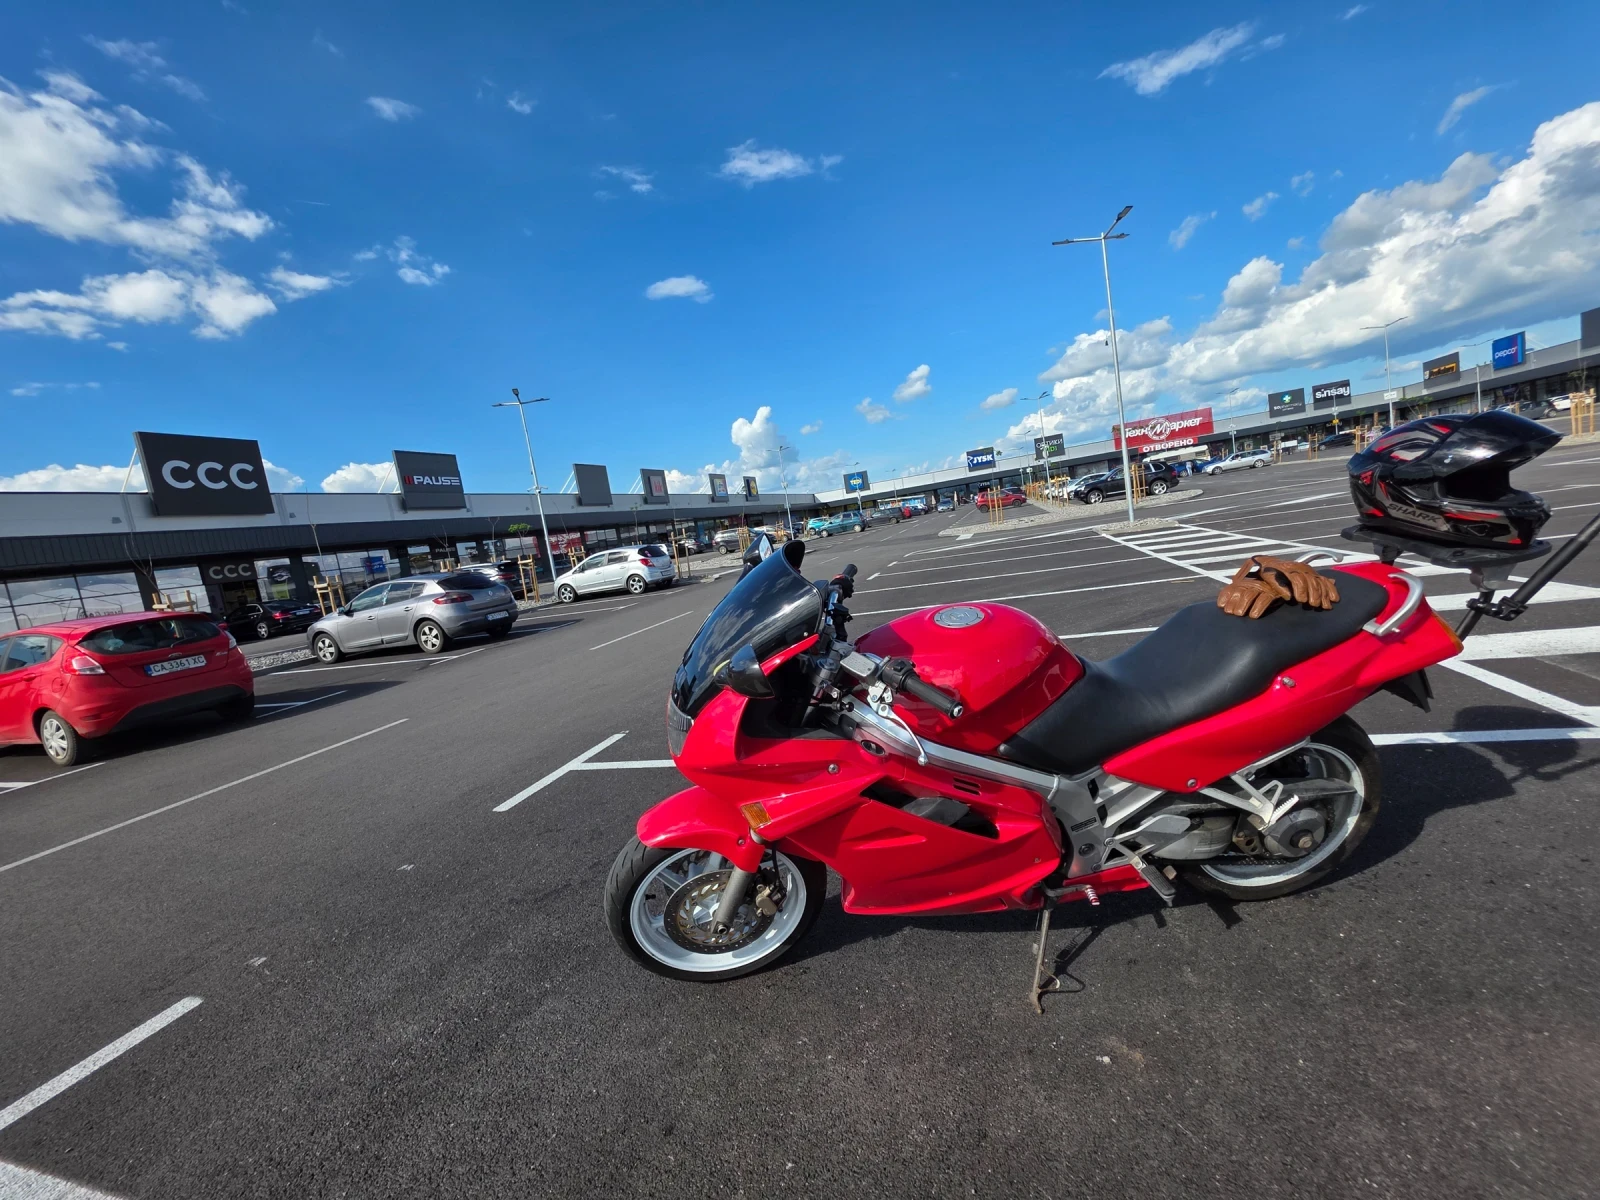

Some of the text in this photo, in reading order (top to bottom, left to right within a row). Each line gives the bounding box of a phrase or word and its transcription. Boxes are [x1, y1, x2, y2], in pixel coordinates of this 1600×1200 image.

[1495, 347, 1518, 359] pepco
[1315, 386, 1350, 399] sinsay
[1142, 438, 1194, 453] ОТВОРЕНО
[972, 454, 993, 464] JYSK
[161, 459, 259, 490] CCC
[413, 475, 461, 486] PAUSE
[1387, 503, 1442, 523] SHARK
[208, 563, 252, 579] CCC
